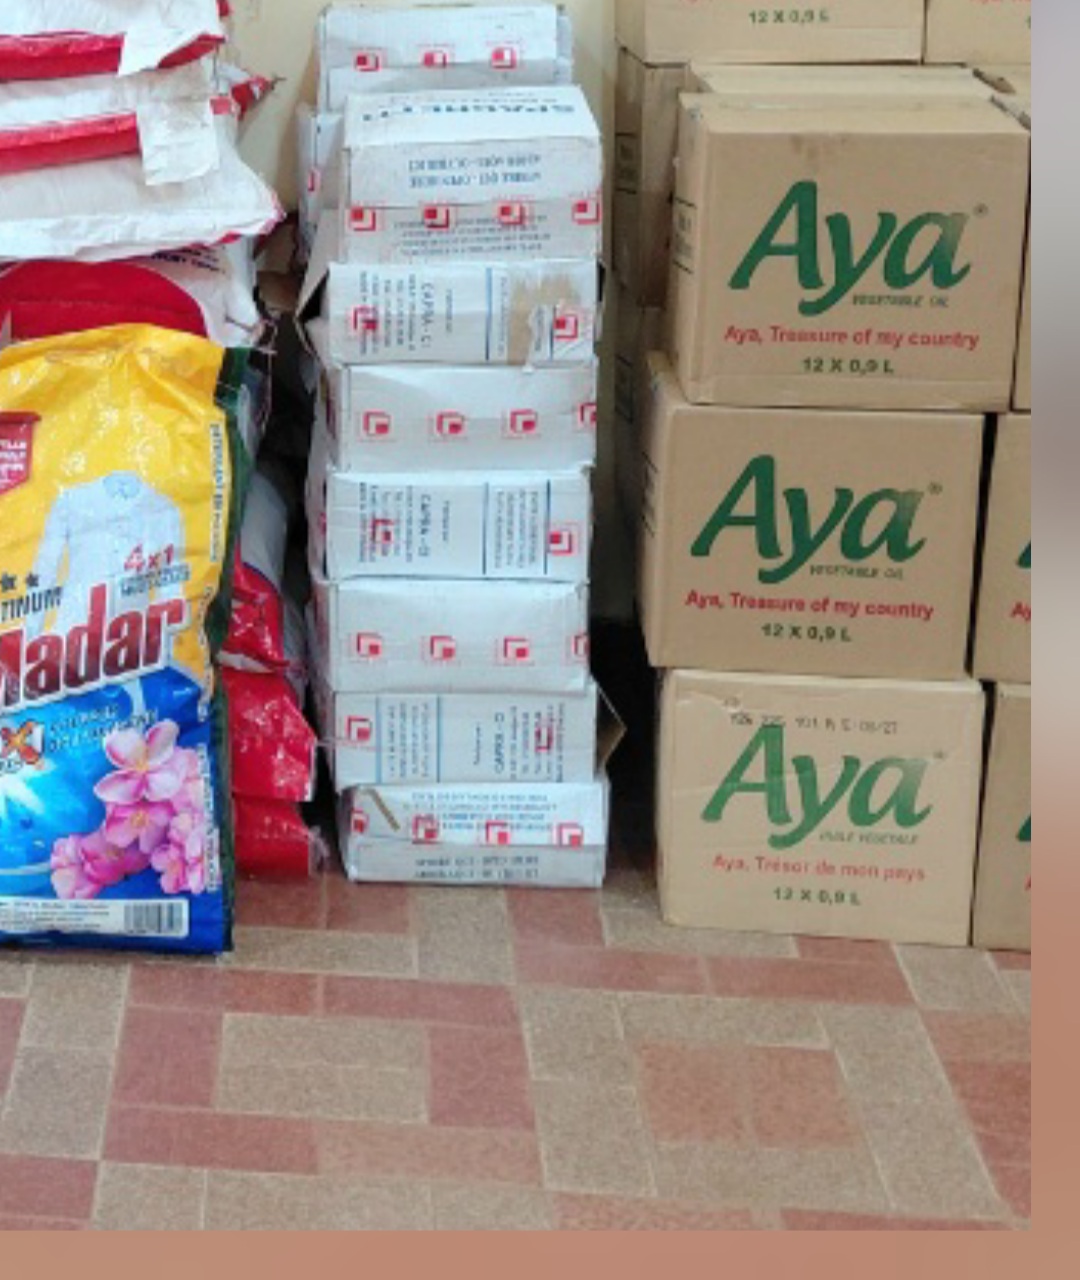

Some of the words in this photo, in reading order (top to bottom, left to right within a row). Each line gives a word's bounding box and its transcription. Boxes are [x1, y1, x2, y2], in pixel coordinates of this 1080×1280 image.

[749, 11, 769, 25] 12
[728, 180, 973, 317] Aya
[724, 325, 763, 346] Aya,
[770, 325, 848, 345] Treasure
[852, 328, 873, 345] of
[877, 332, 905, 350] my
[908, 333, 980, 351] country
[803, 358, 825, 373] 12
[829, 359, 844, 373] X
[849, 359, 878, 376] 0,9
[883, 359, 895, 374] L
[690, 454, 928, 584] Aya
[686, 590, 725, 610] Aya,
[730, 592, 807, 613] Treasure
[811, 597, 831, 613] of
[834, 601, 860, 617] my
[865, 602, 934, 621] country
[761, 624, 784, 637] 12
[790, 624, 802, 638] X
[807, 626, 837, 642] 0,9
[841, 627, 852, 642] L
[701, 724, 934, 850] Aya
[713, 854, 750, 872] Aya,
[816, 860, 836, 876] de
[841, 865, 879, 879] mon
[883, 866, 925, 883] pays
[773, 887, 795, 901] 12
[800, 888, 812, 902] X
